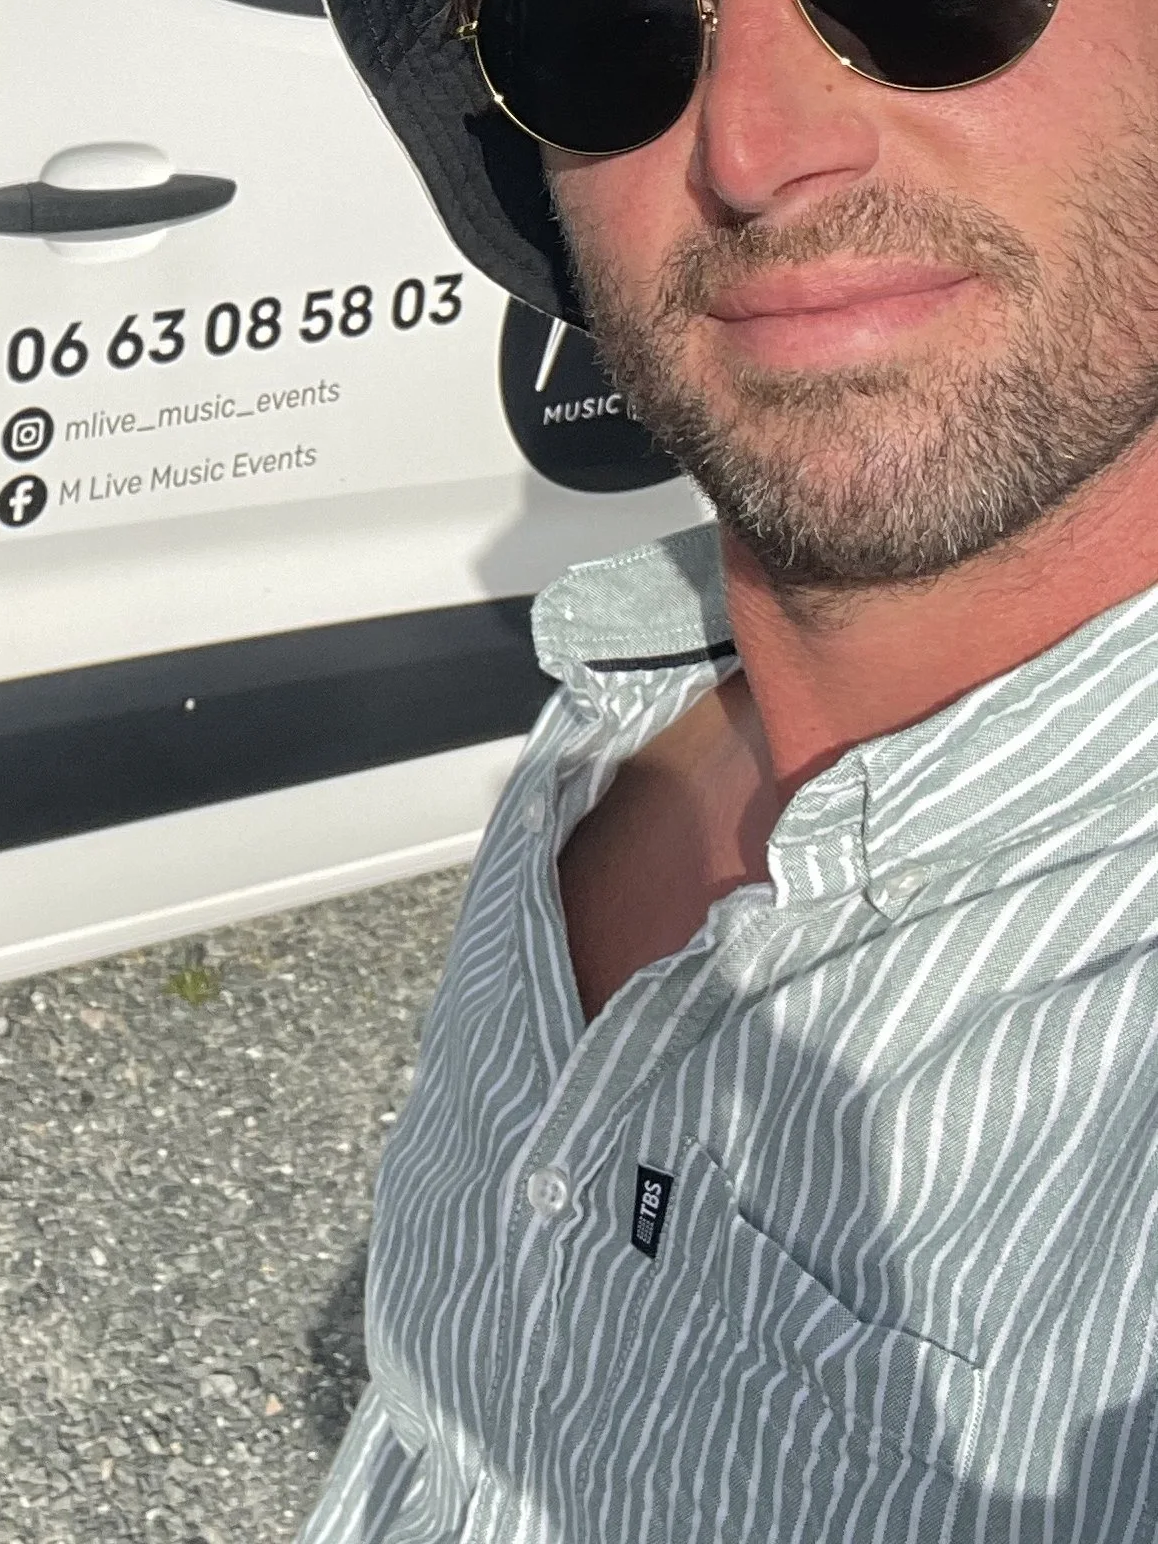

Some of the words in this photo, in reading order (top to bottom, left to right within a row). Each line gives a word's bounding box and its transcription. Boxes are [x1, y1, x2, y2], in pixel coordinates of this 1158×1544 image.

[6, 320, 89, 384] 06
[106, 308, 186, 370] 63
[205, 296, 281, 356] 08
[298, 284, 373, 344] 58
[391, 273, 463, 331] 03
[65, 379, 340, 442] mlive_music_events
[542, 393, 623, 426] MUSIC
[58, 477, 81, 506] M
[88, 472, 142, 501] Live
[150, 458, 225, 492] Music
[231, 444, 318, 478] Events
[639, 1179, 662, 1220] TBS
